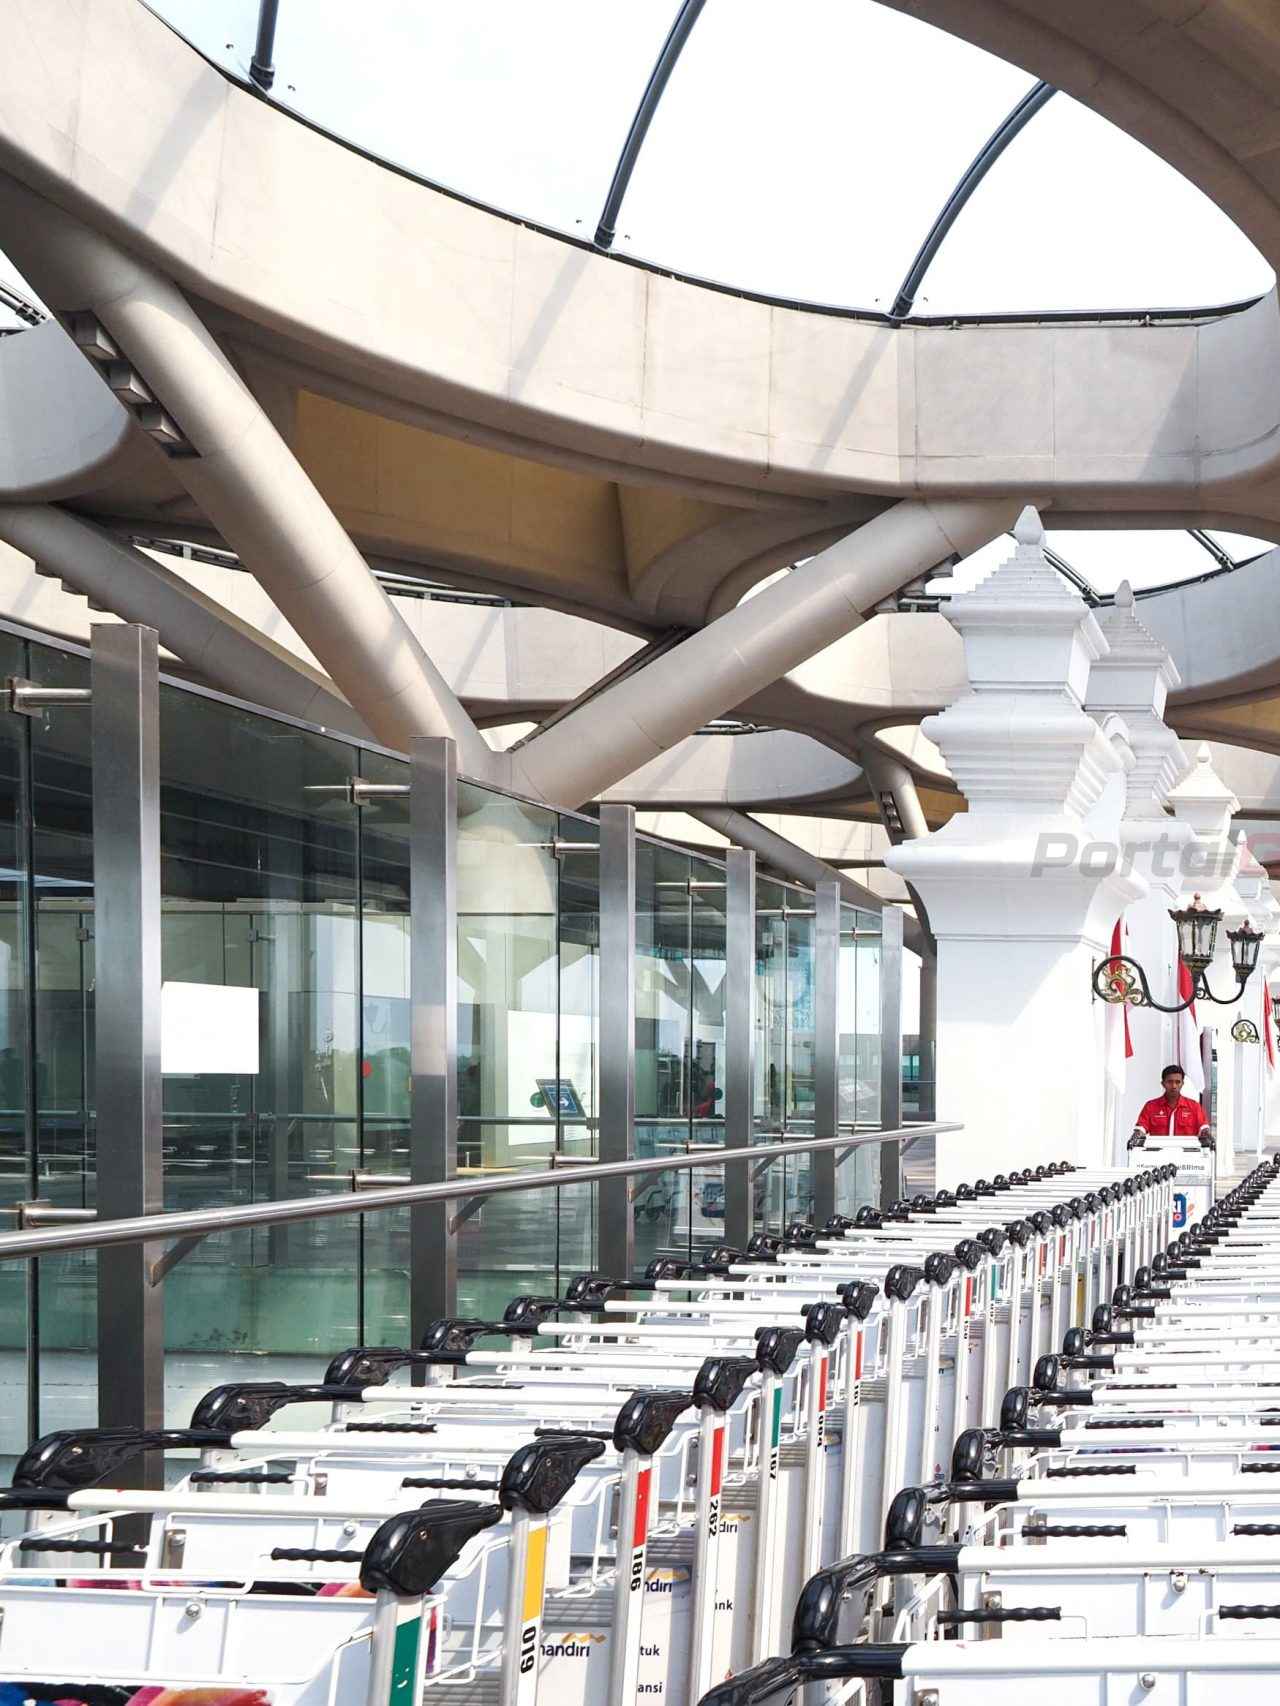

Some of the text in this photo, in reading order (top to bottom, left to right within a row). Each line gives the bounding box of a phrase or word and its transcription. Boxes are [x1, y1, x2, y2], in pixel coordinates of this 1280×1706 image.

[708, 1498, 719, 1539] 262
[630, 1550, 644, 1592] 186
[520, 1625, 537, 1674] 019
